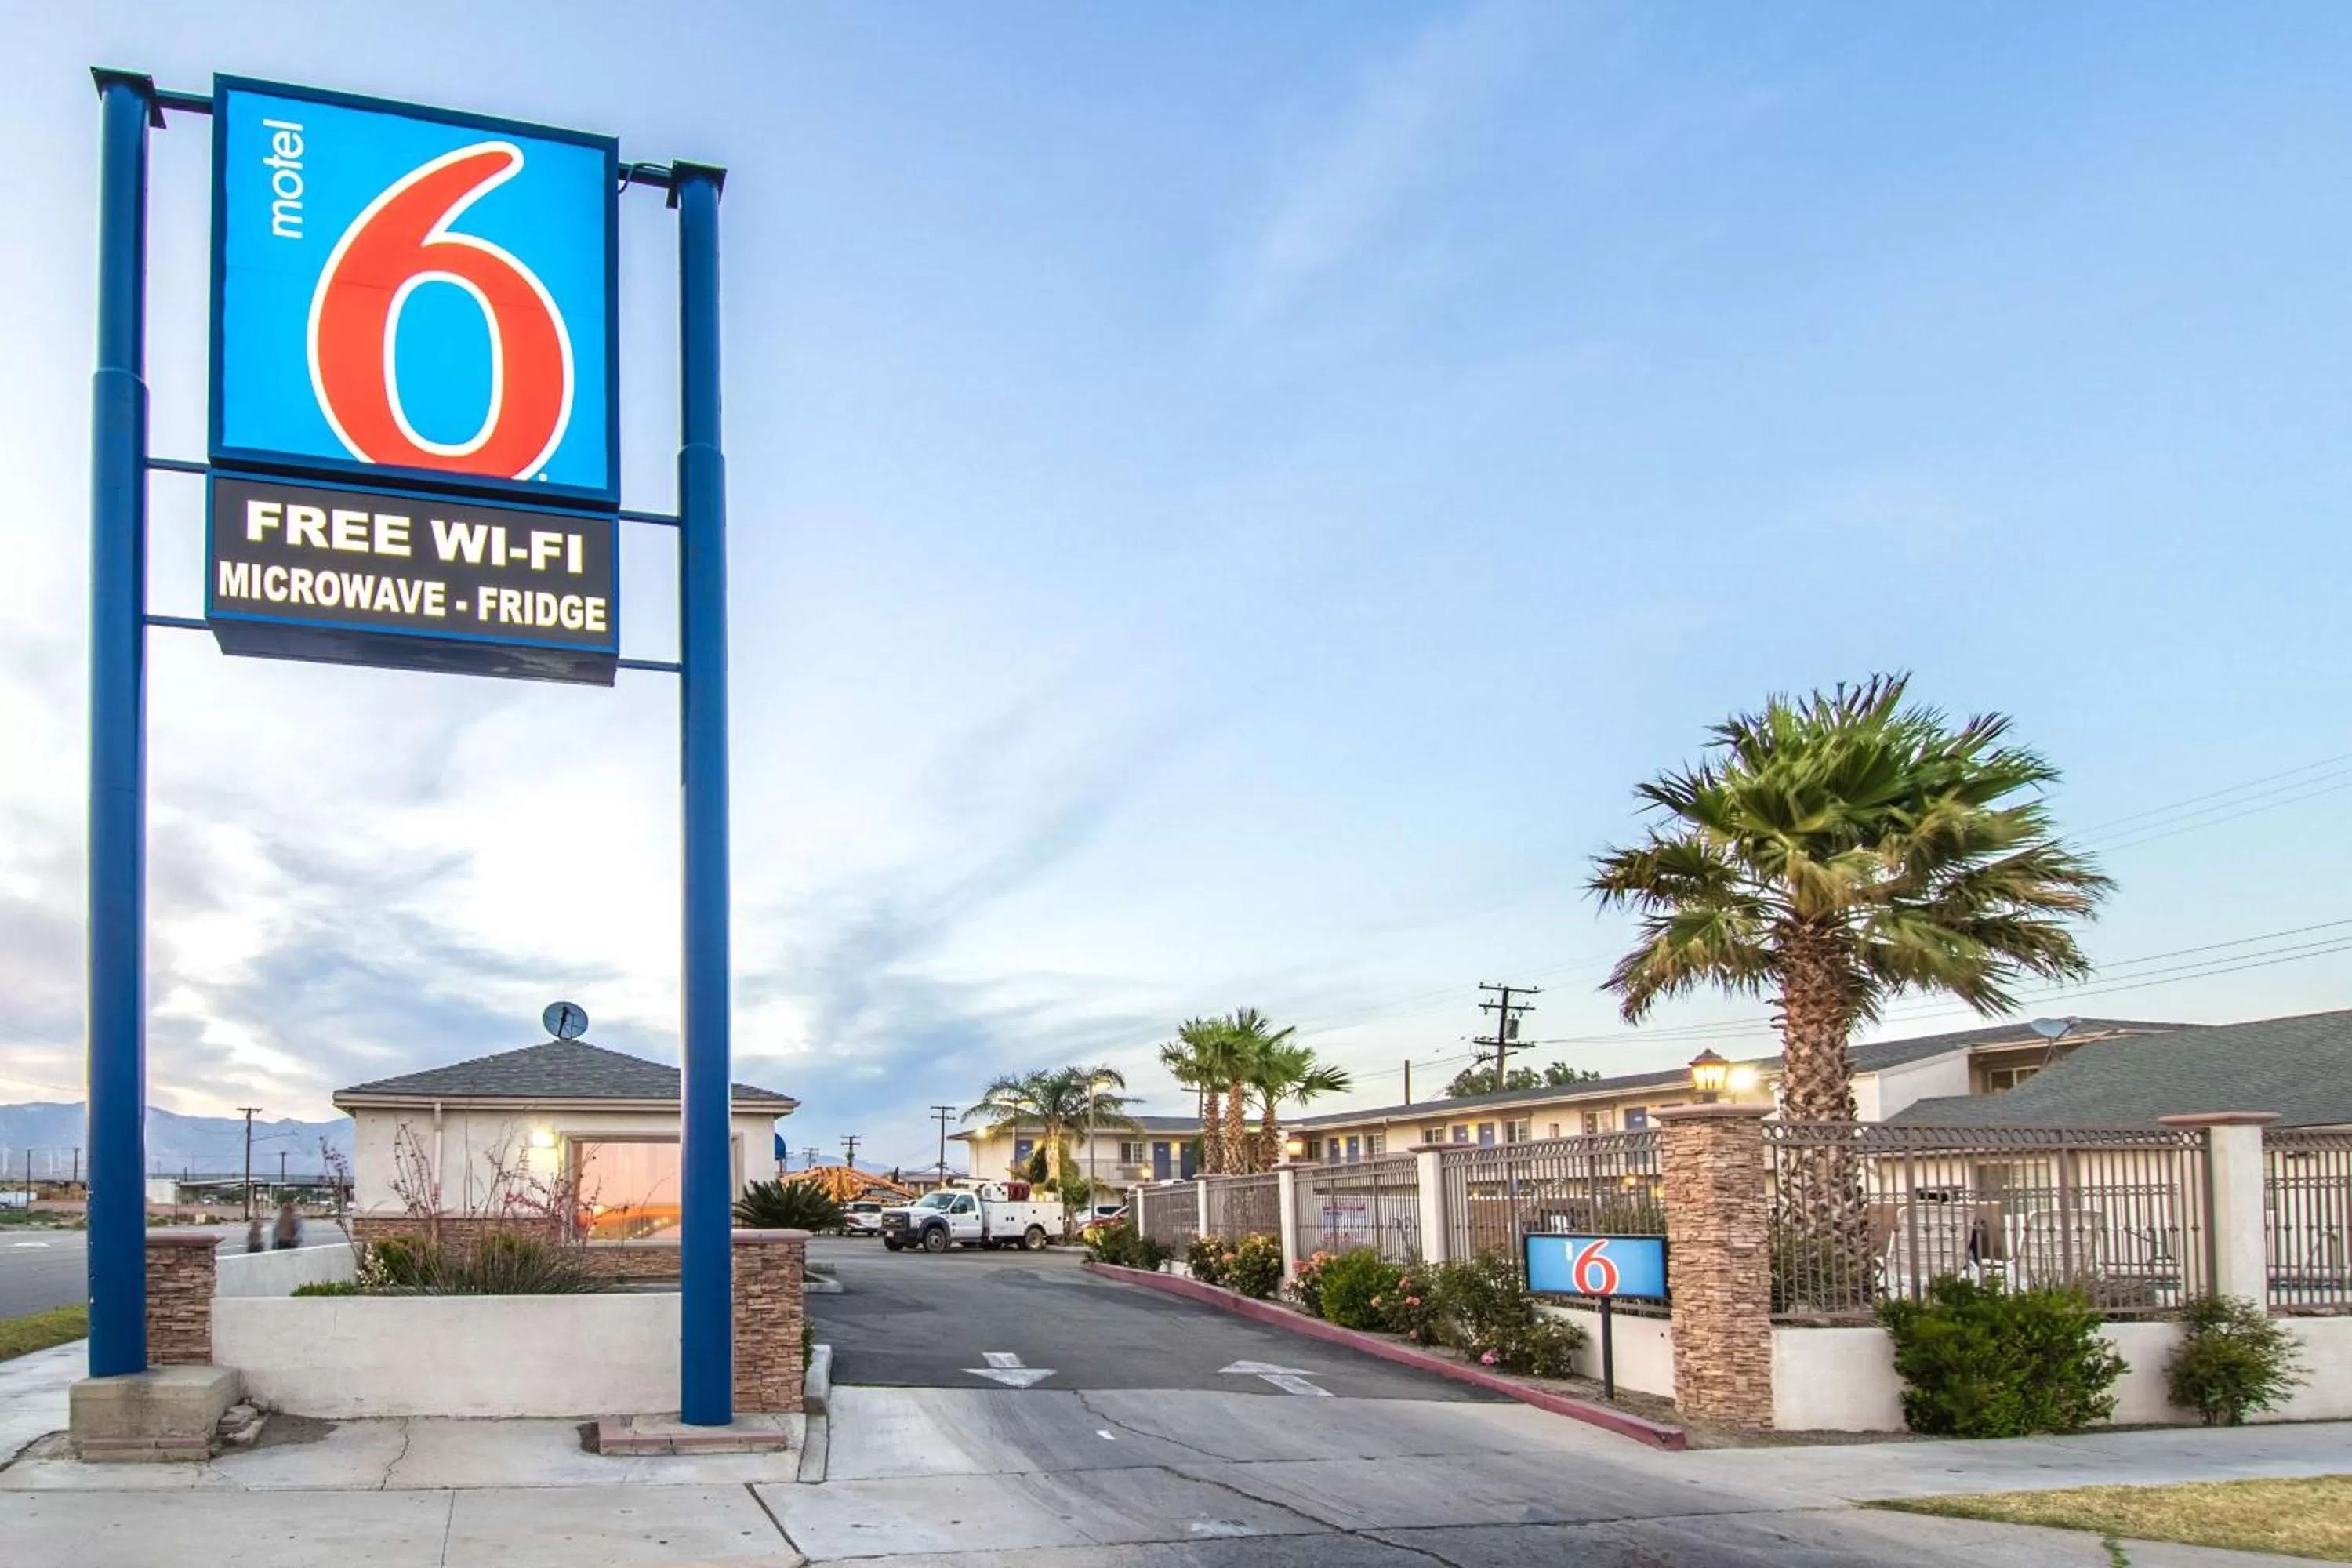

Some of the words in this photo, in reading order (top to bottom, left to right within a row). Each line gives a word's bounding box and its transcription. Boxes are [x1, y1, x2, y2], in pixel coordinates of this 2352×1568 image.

[263, 118, 304, 239] motel
[306, 140, 575, 481] 6
[246, 499, 412, 557] FREE
[430, 519, 583, 575] WI-FI
[219, 561, 446, 617] MICROWAVE
[477, 586, 607, 632] FRIDGE
[1572, 1239, 1620, 1296] 6
